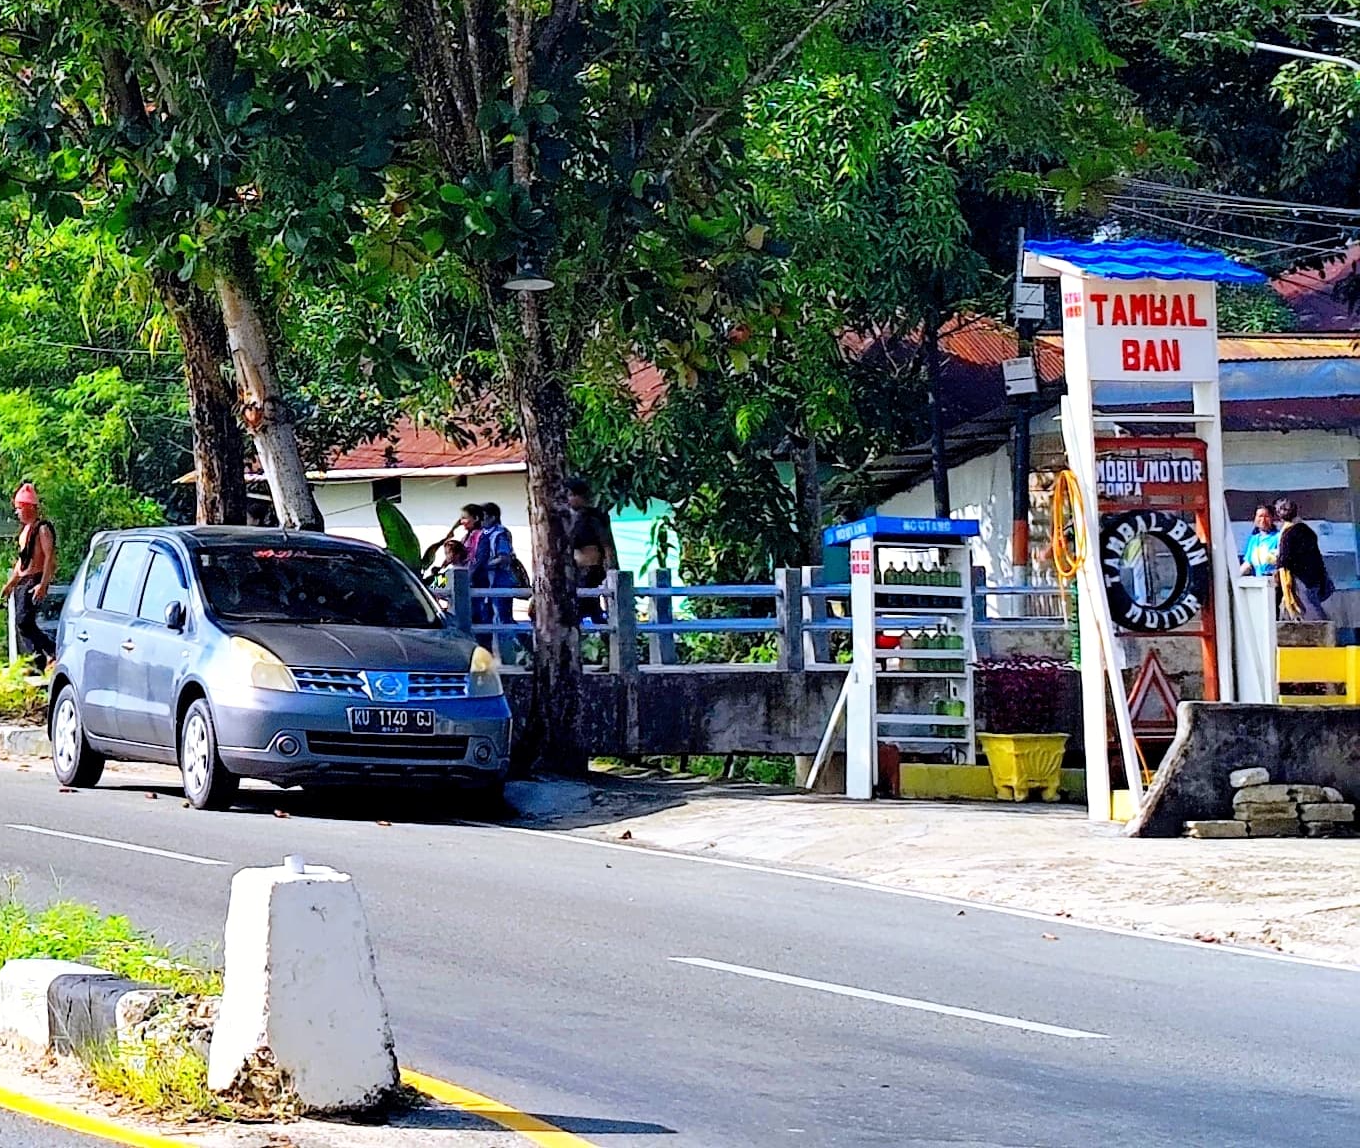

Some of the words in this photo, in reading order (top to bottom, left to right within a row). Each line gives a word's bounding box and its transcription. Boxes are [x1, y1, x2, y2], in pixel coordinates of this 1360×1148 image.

[1090, 293, 1207, 327] TAMBAL
[1122, 339, 1180, 371] BAN
[1104, 513, 1163, 587] TAMBAL
[1168, 519, 1208, 566] BAN
[354, 710, 370, 725] KU
[379, 710, 408, 725] 1140
[416, 711, 432, 726] GJ
